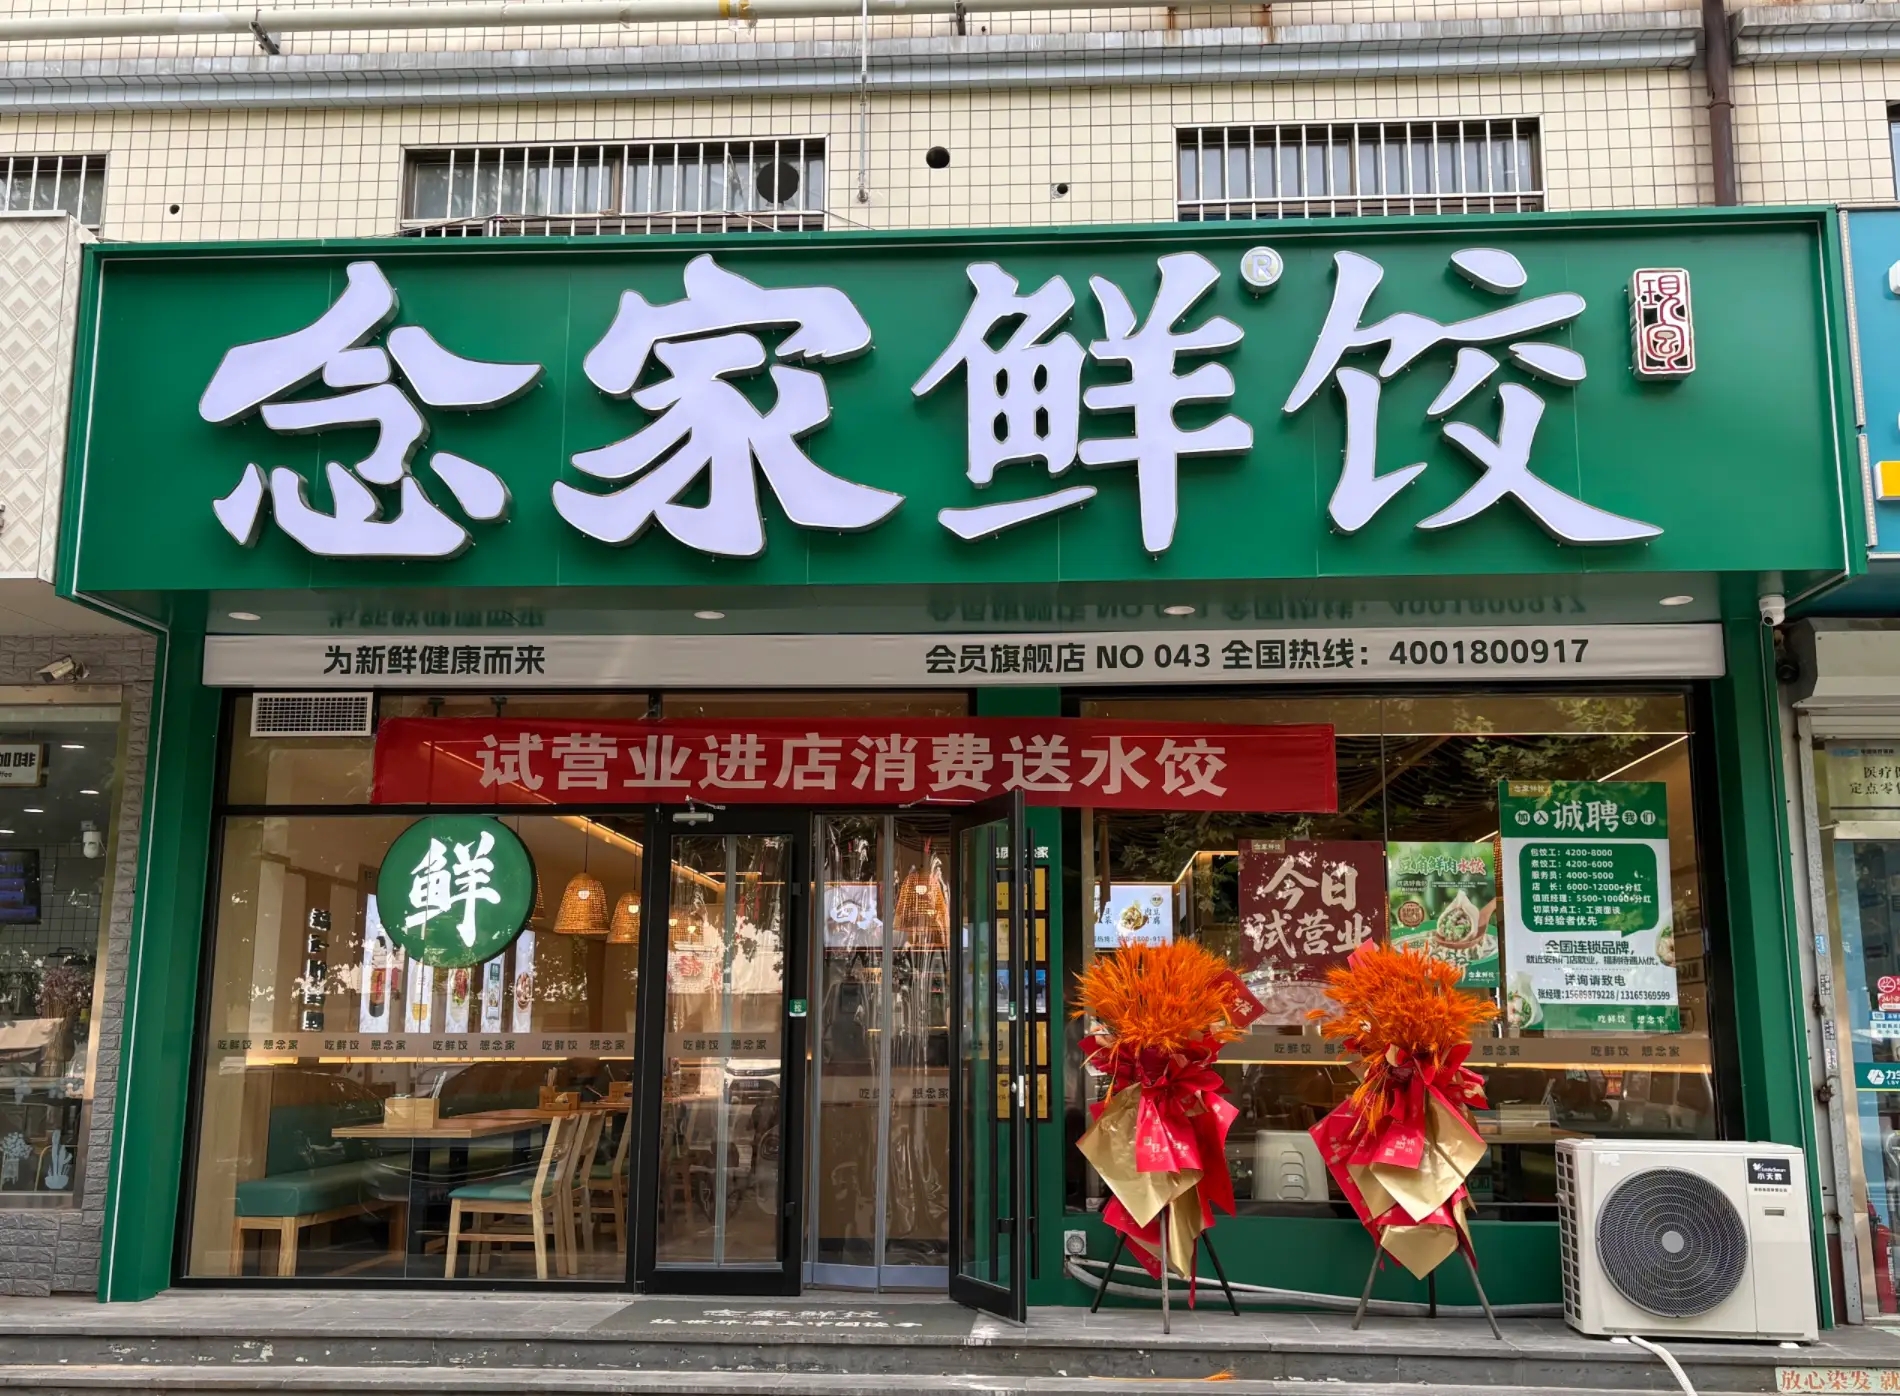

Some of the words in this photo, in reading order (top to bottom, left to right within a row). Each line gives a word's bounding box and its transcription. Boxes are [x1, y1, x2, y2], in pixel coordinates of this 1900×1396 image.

[199, 247, 1664, 559] 念家鲜饺
[324, 645, 546, 675] 为新鲜健康而来
[925, 643, 1086, 674] 会员旗舰店
[1096, 644, 1144, 669] NO
[1153, 643, 1211, 668] 043
[475, 732, 1229, 798] 试营业进店消费送水饺
[1551, 799, 1620, 833] 诚聘
[403, 830, 502, 949] 鲜
[1262, 854, 1359, 912] 今日
[1244, 908, 1380, 960] 试营业
[1781, 1370, 1872, 1391] 放心染发
